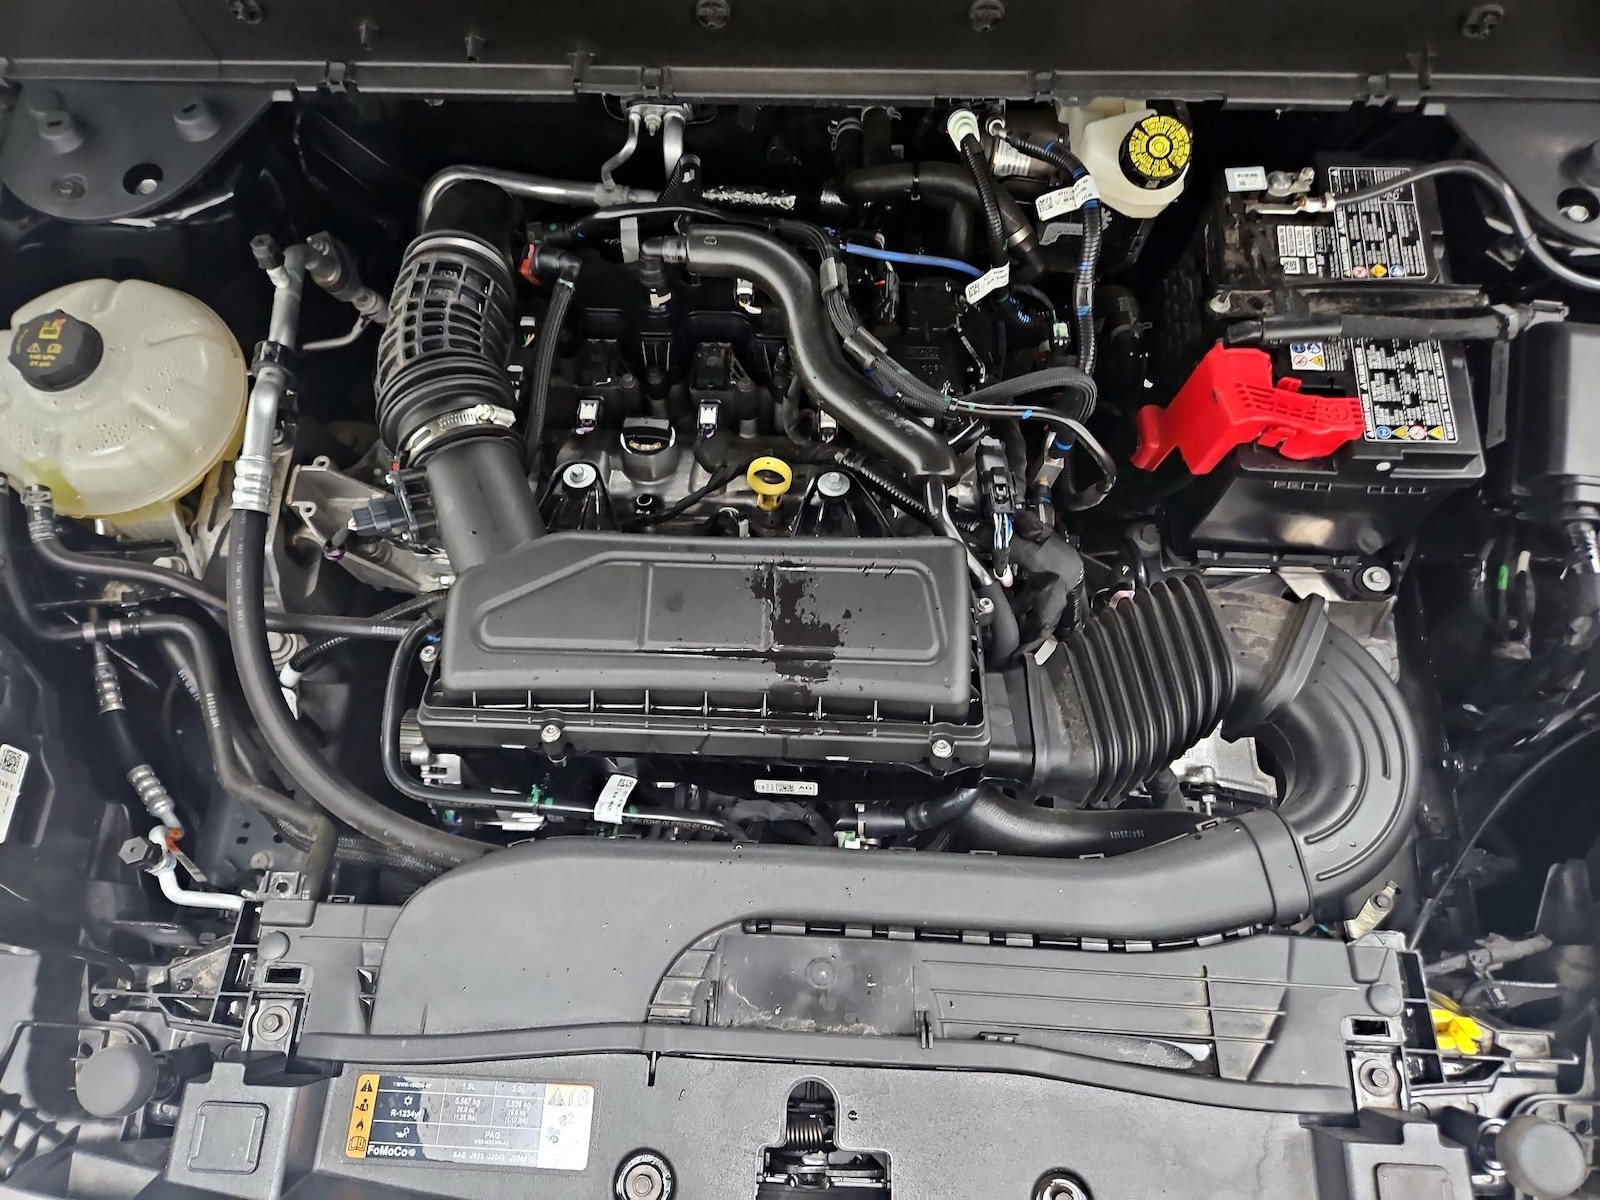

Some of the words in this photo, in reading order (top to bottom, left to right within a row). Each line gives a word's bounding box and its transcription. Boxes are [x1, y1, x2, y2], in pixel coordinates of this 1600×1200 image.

[472, 1098, 481, 1108] kg
[484, 1131, 501, 1140] PAG
[367, 1145, 408, 1157] FoMoCo
[452, 1151, 466, 1159] SAE
